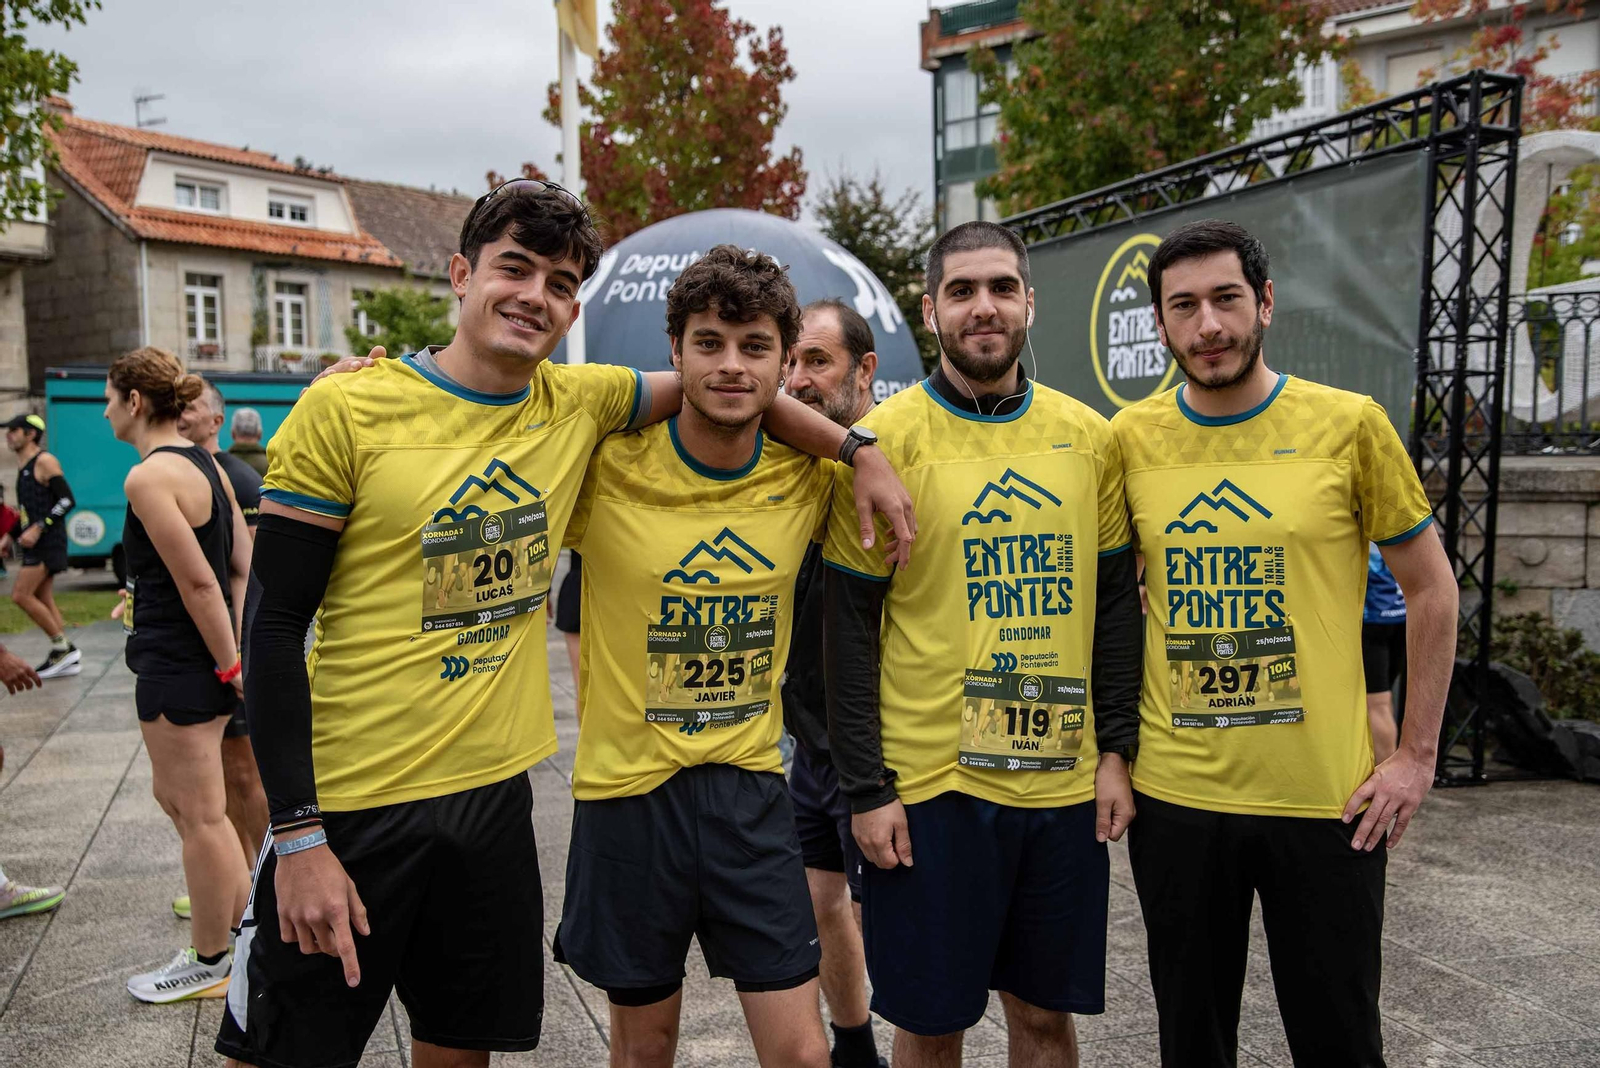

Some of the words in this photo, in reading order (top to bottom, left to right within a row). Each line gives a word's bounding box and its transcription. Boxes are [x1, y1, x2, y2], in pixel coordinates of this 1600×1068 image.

[1107, 344, 1167, 381] PONTES
[422, 529, 459, 539] XORNADA
[459, 527, 464, 535] 3
[422, 535, 457, 545] GONDOMAR
[1057, 533, 1064, 541] &
[529, 539, 546, 557] 10K
[963, 533, 1057, 578] ENTRE
[1064, 534, 1074, 573] RUNNING
[1264, 546, 1274, 554] &
[473, 549, 513, 587] 20
[1165, 546, 1264, 586] ENTRE
[1264, 558, 1274, 585] TRAIL
[1274, 546, 1285, 586] RUNNING
[476, 583, 513, 602] LUCAS
[967, 576, 1073, 621] PONTES
[1167, 589, 1286, 628] PONTES
[457, 624, 510, 646] GONDOMAR
[999, 626, 1051, 642] GONDOMAR
[752, 654, 770, 669] 10K
[1020, 652, 1059, 661] Deputación
[1020, 660, 1059, 669] Pontevedra
[683, 657, 745, 689] 225
[1269, 660, 1293, 675] 10K
[1198, 663, 1260, 695] 297
[694, 690, 736, 703] JAVIER
[1208, 694, 1256, 709] ADRIÁN
[1005, 706, 1050, 737] 119
[1063, 712, 1082, 724] 10K
[1012, 738, 1039, 751] IVÁN
[287, 835, 316, 850] CELTA
[153, 970, 214, 991] KIPRUN
